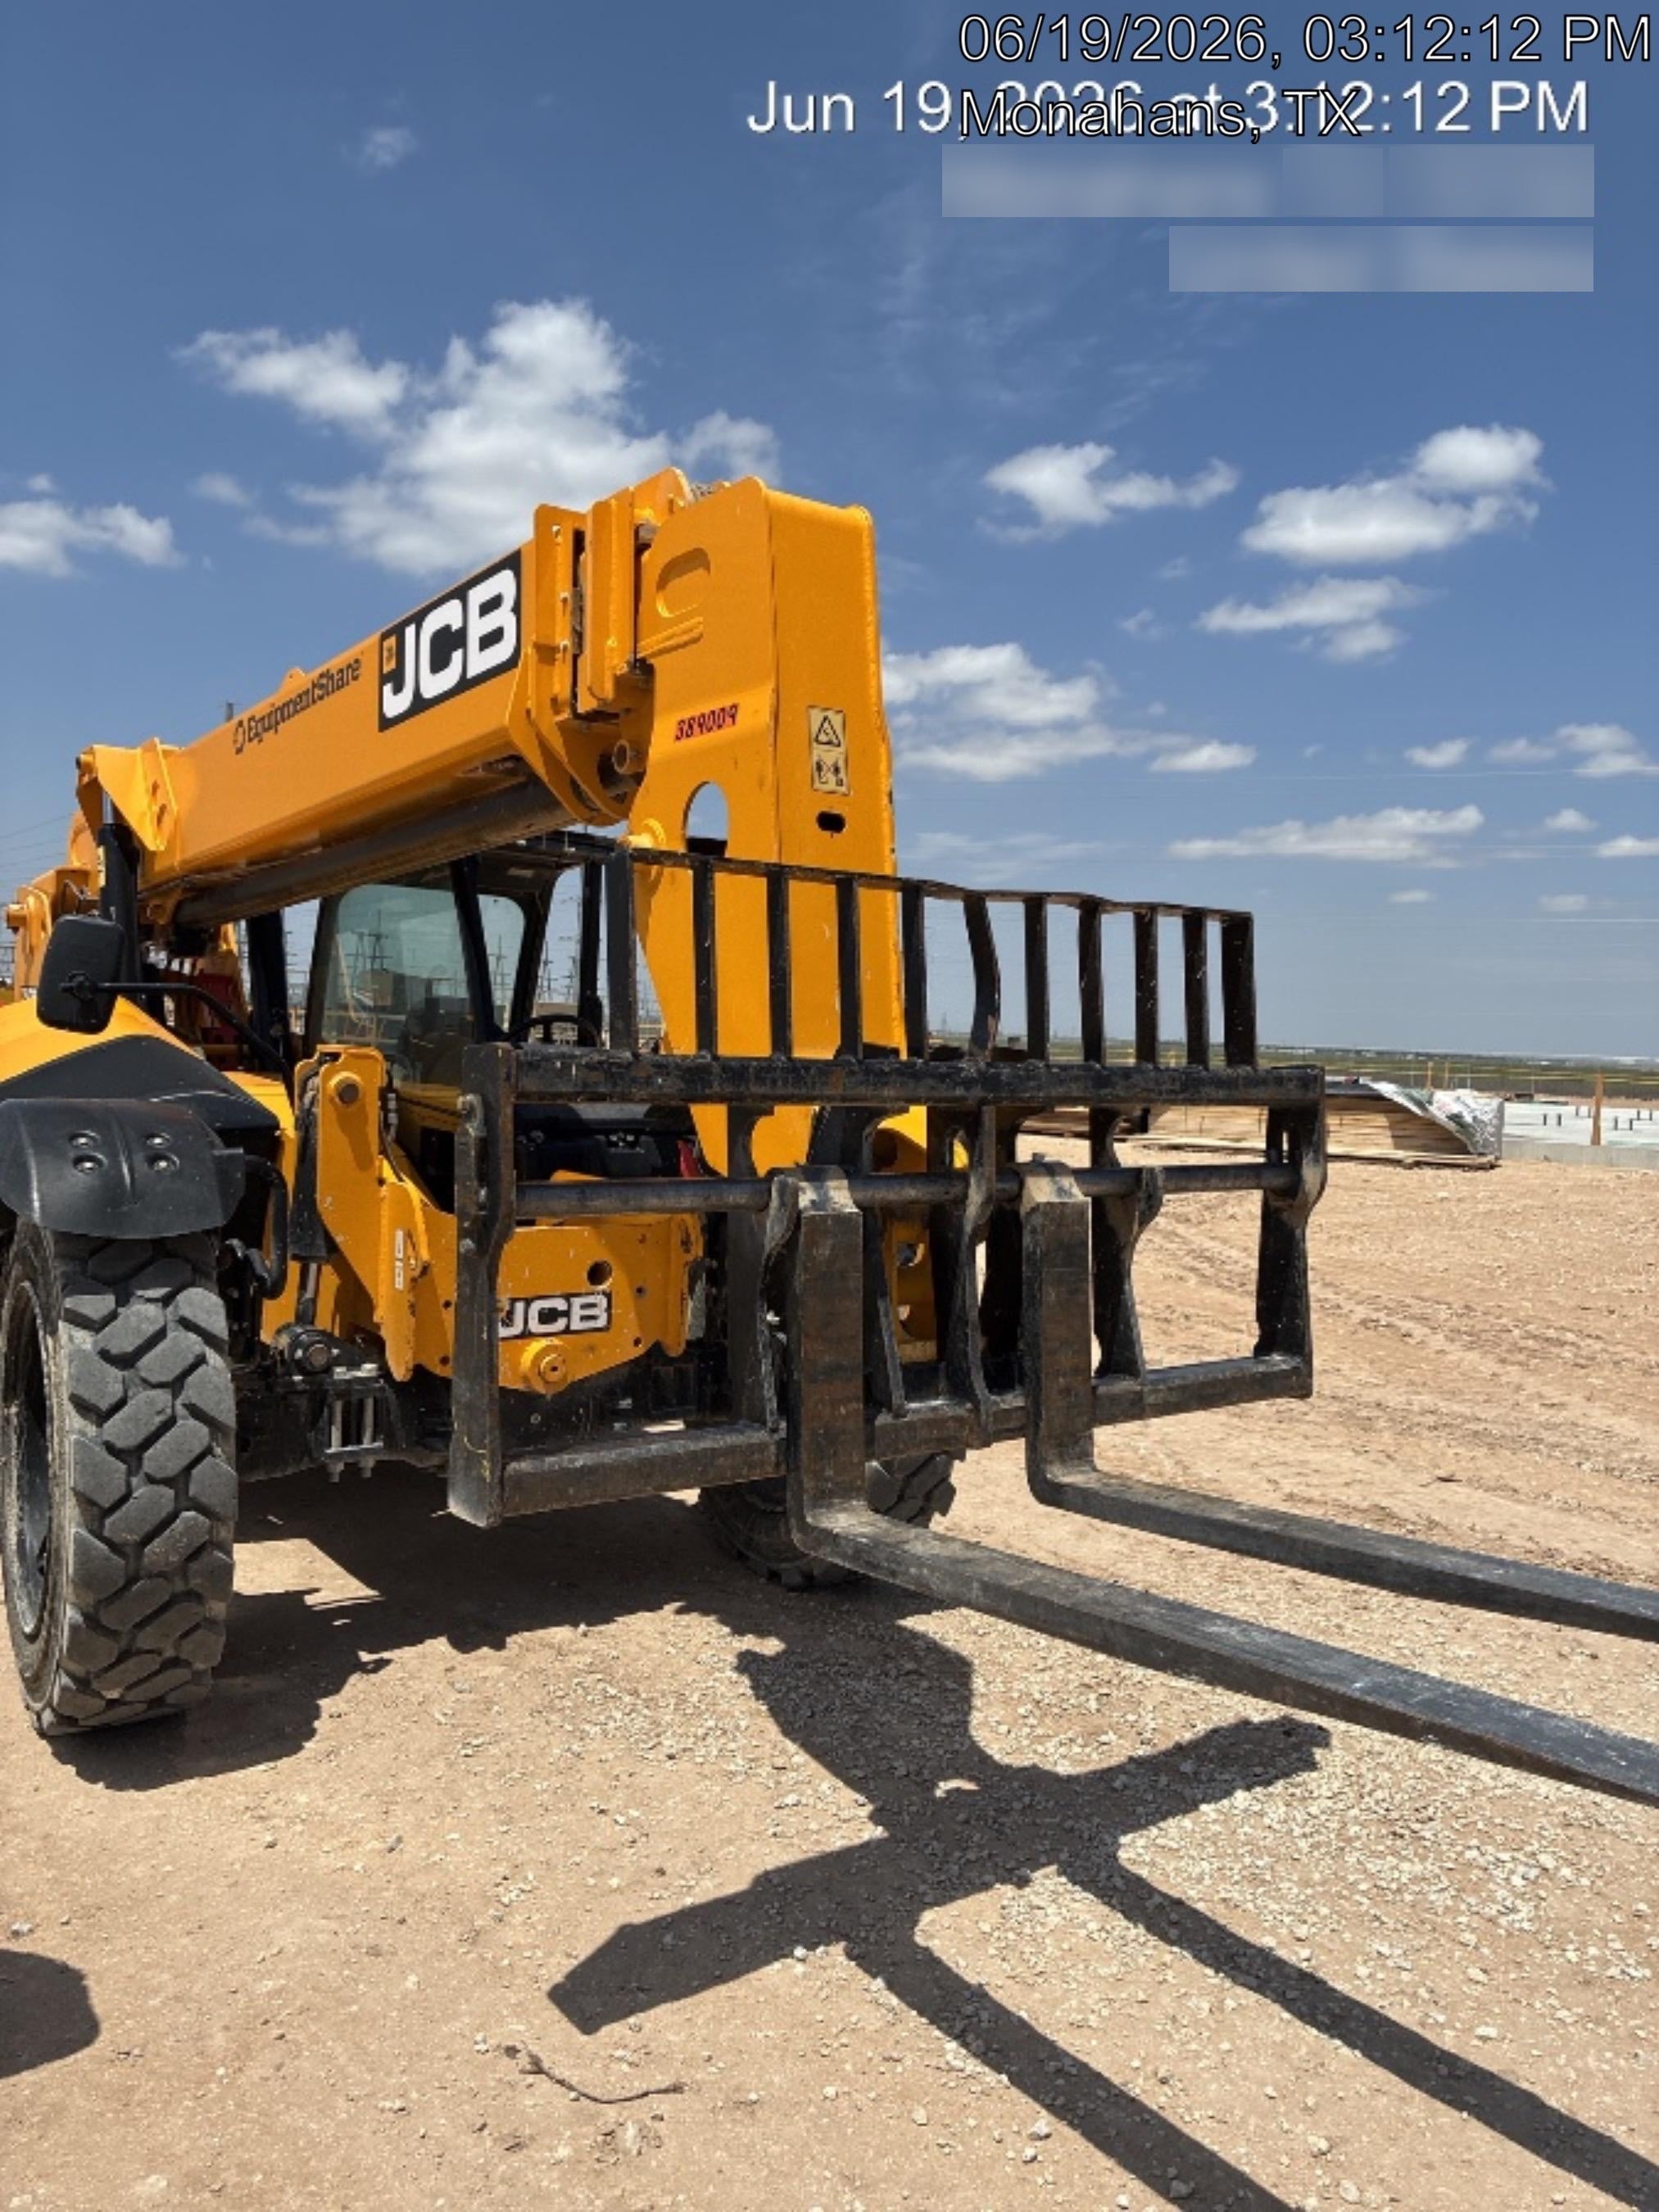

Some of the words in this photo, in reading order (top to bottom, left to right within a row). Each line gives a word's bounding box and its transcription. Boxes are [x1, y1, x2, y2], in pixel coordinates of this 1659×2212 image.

[382, 568, 518, 719] JCB
[247, 658, 362, 745] EquipmentShare
[498, 1294, 609, 1339] JCB
